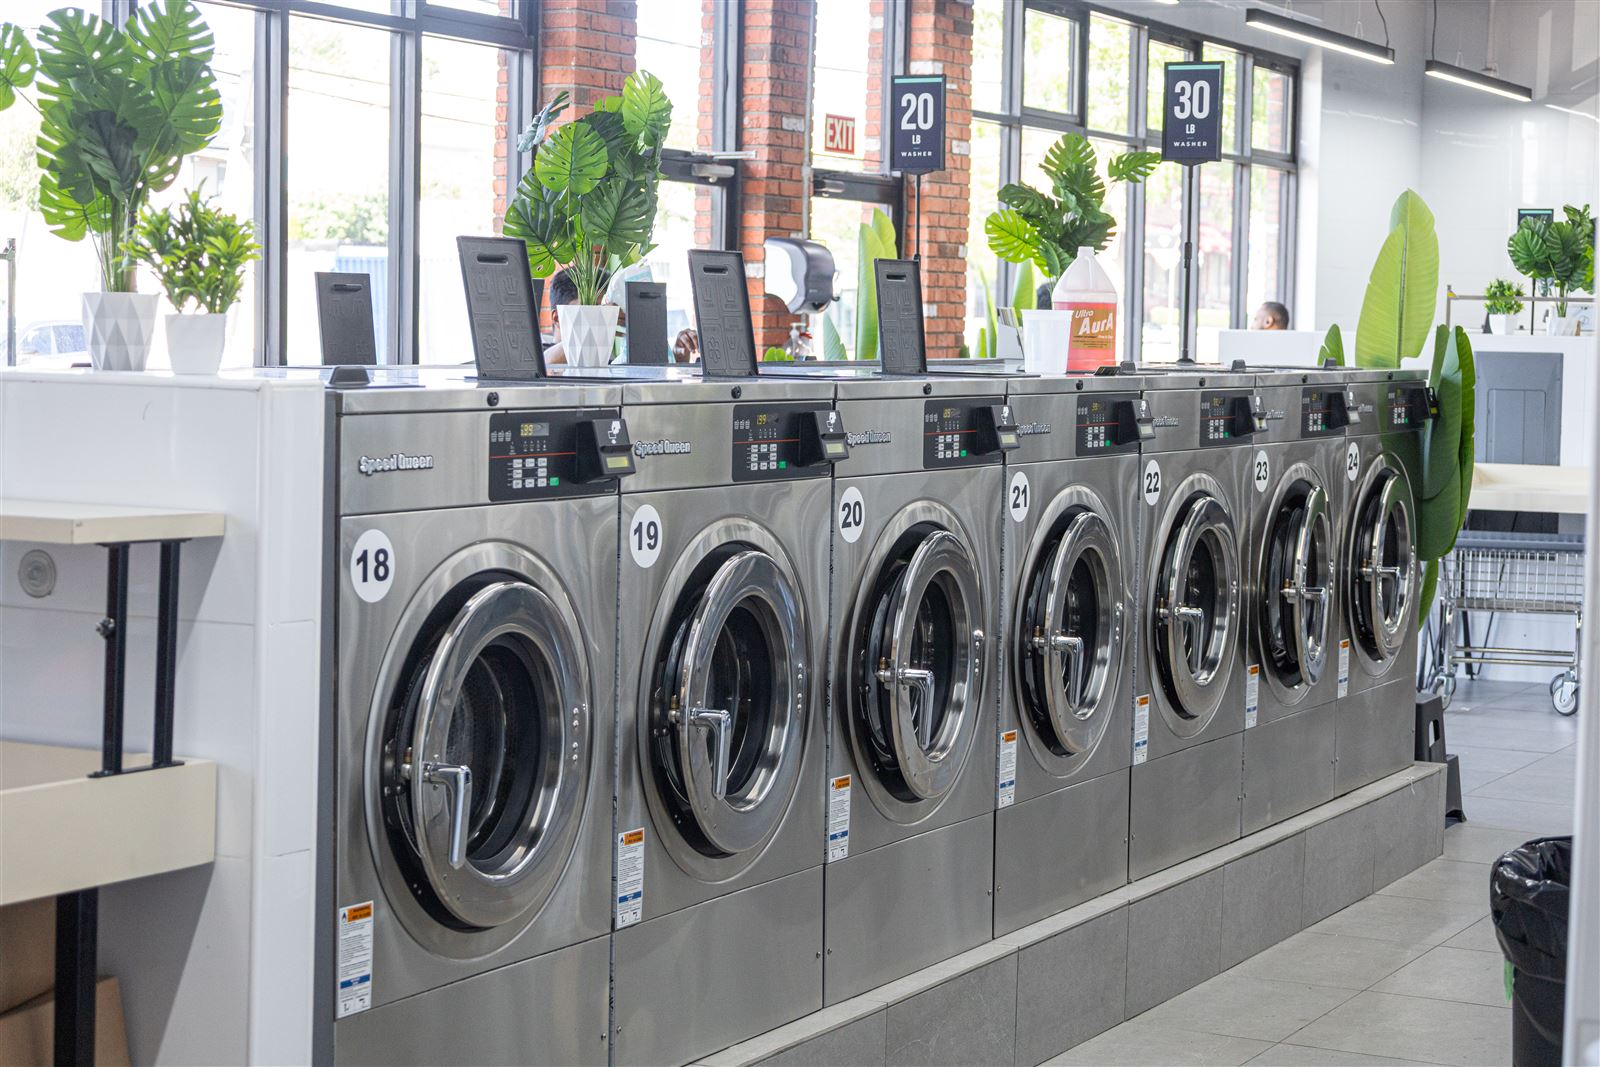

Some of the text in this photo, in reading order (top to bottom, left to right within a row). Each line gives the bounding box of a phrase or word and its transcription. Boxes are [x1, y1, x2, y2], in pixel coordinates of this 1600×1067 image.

[901, 92, 934, 130] 20
[1174, 80, 1210, 119] 30
[826, 117, 855, 151] EXIT
[911, 134, 921, 145] LB
[1185, 124, 1196, 134] LB
[1075, 309, 1094, 319] Ultra
[635, 439, 691, 459] Speed Queen
[359, 452, 433, 476] Speed Queen
[1256, 461, 1268, 481] 23
[1348, 452, 1358, 471] 24
[1146, 471, 1160, 494] 22
[1012, 484, 1028, 509] 21
[841, 500, 863, 529] 20
[633, 520, 659, 551] 19
[356, 548, 390, 583] 18
